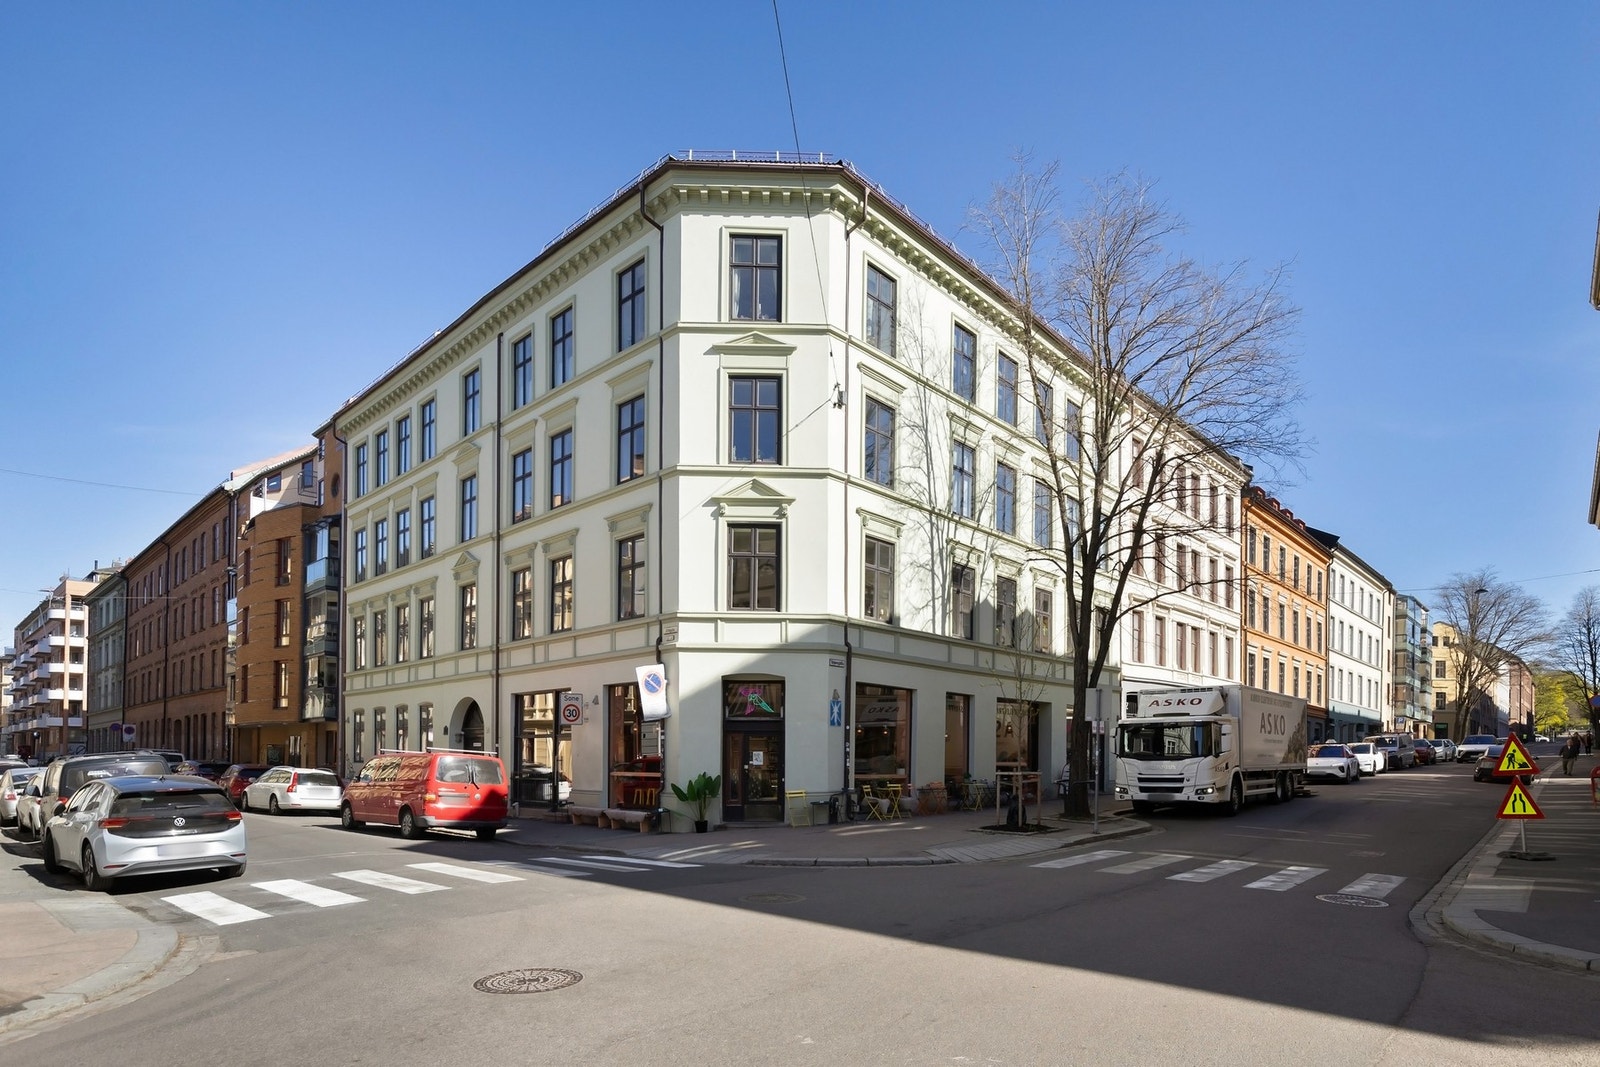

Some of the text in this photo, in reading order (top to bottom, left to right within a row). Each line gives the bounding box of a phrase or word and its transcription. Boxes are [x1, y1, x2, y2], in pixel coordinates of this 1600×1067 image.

[1148, 698, 1202, 707] ASKO
[566, 708, 577, 718] 30
[1260, 712, 1286, 736] ASKO
